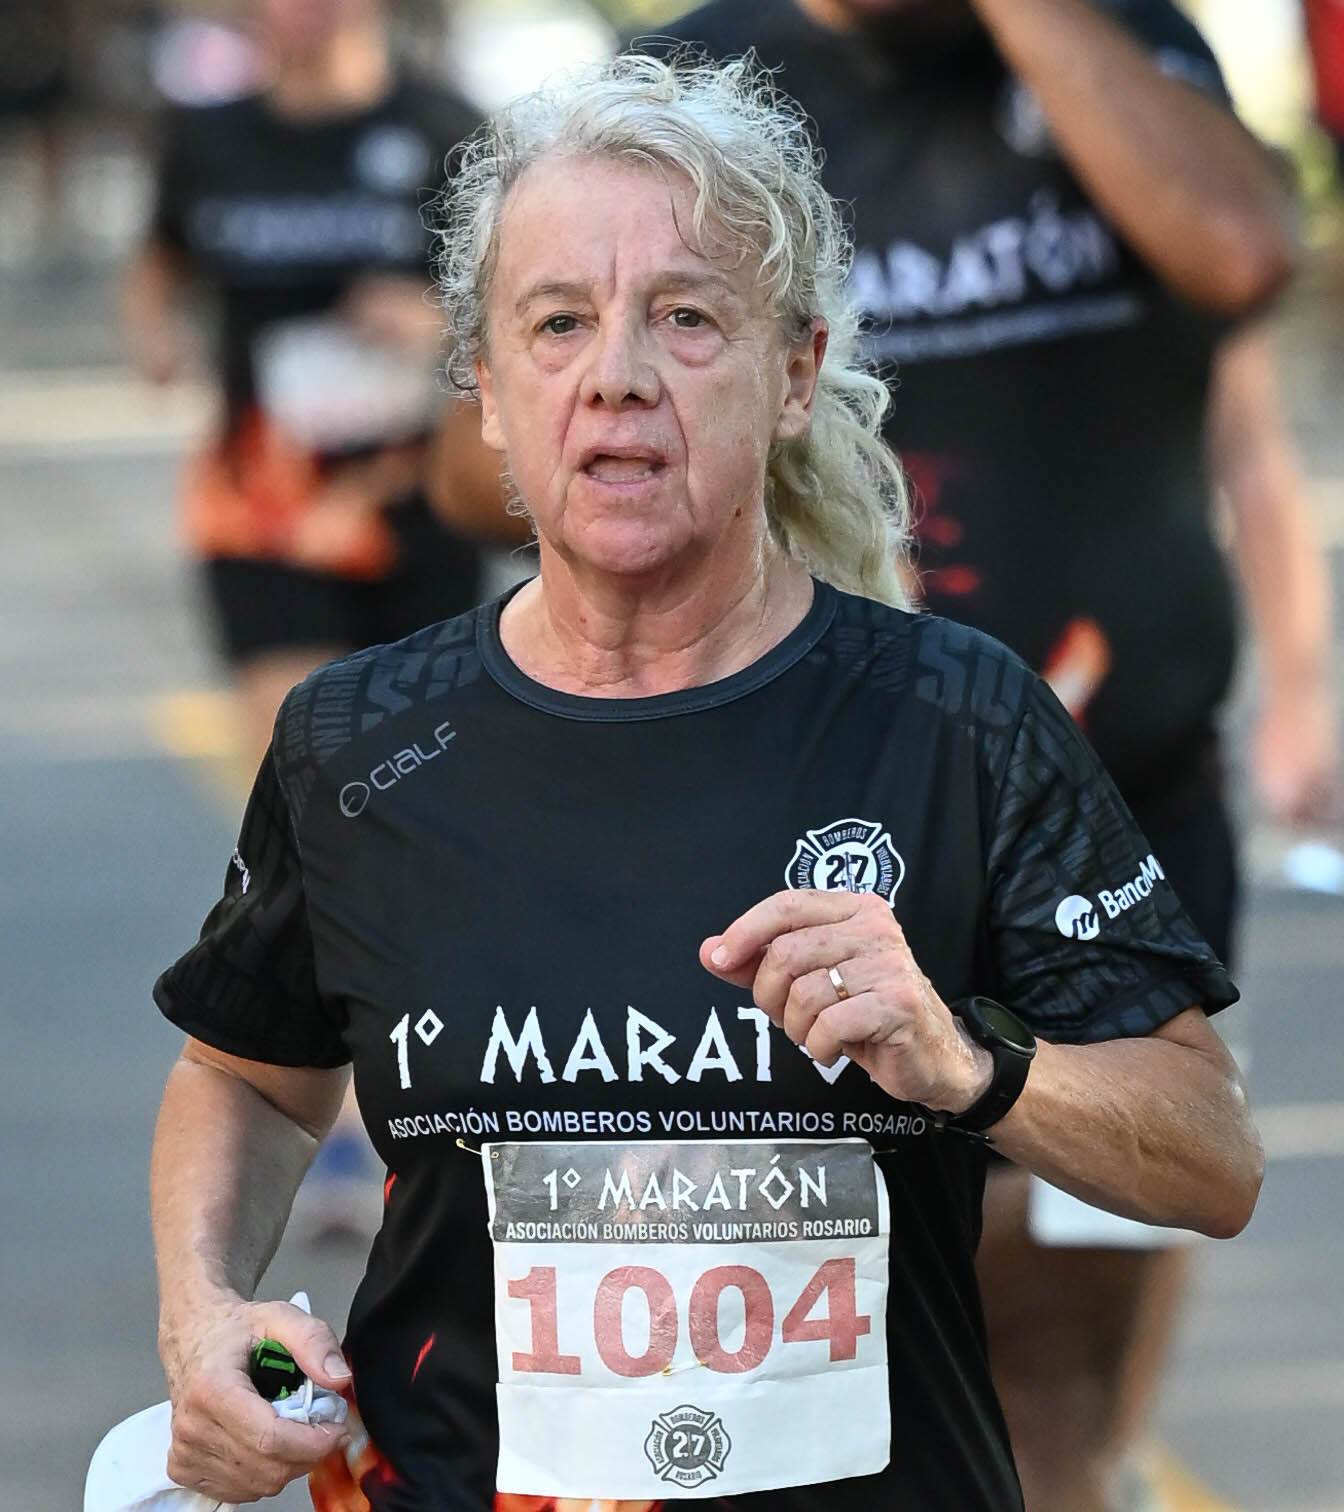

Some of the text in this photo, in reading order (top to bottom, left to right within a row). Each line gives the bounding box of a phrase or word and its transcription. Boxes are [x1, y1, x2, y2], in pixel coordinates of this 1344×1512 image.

[825, 853, 870, 890] 27
[479, 1005, 853, 1086] MARAT
[387, 1107, 927, 1140] ASOCIACIÓN BOMBEROS VOLUNTARIOS ROSARIO
[596, 1153, 829, 1213] MARATÓN
[505, 1217, 873, 1241] ASOCIACIÓN BOMBEROS VOLUNTARIOS ROSARIO
[507, 1256, 872, 1379] 1004
[672, 1430, 706, 1459] 27
